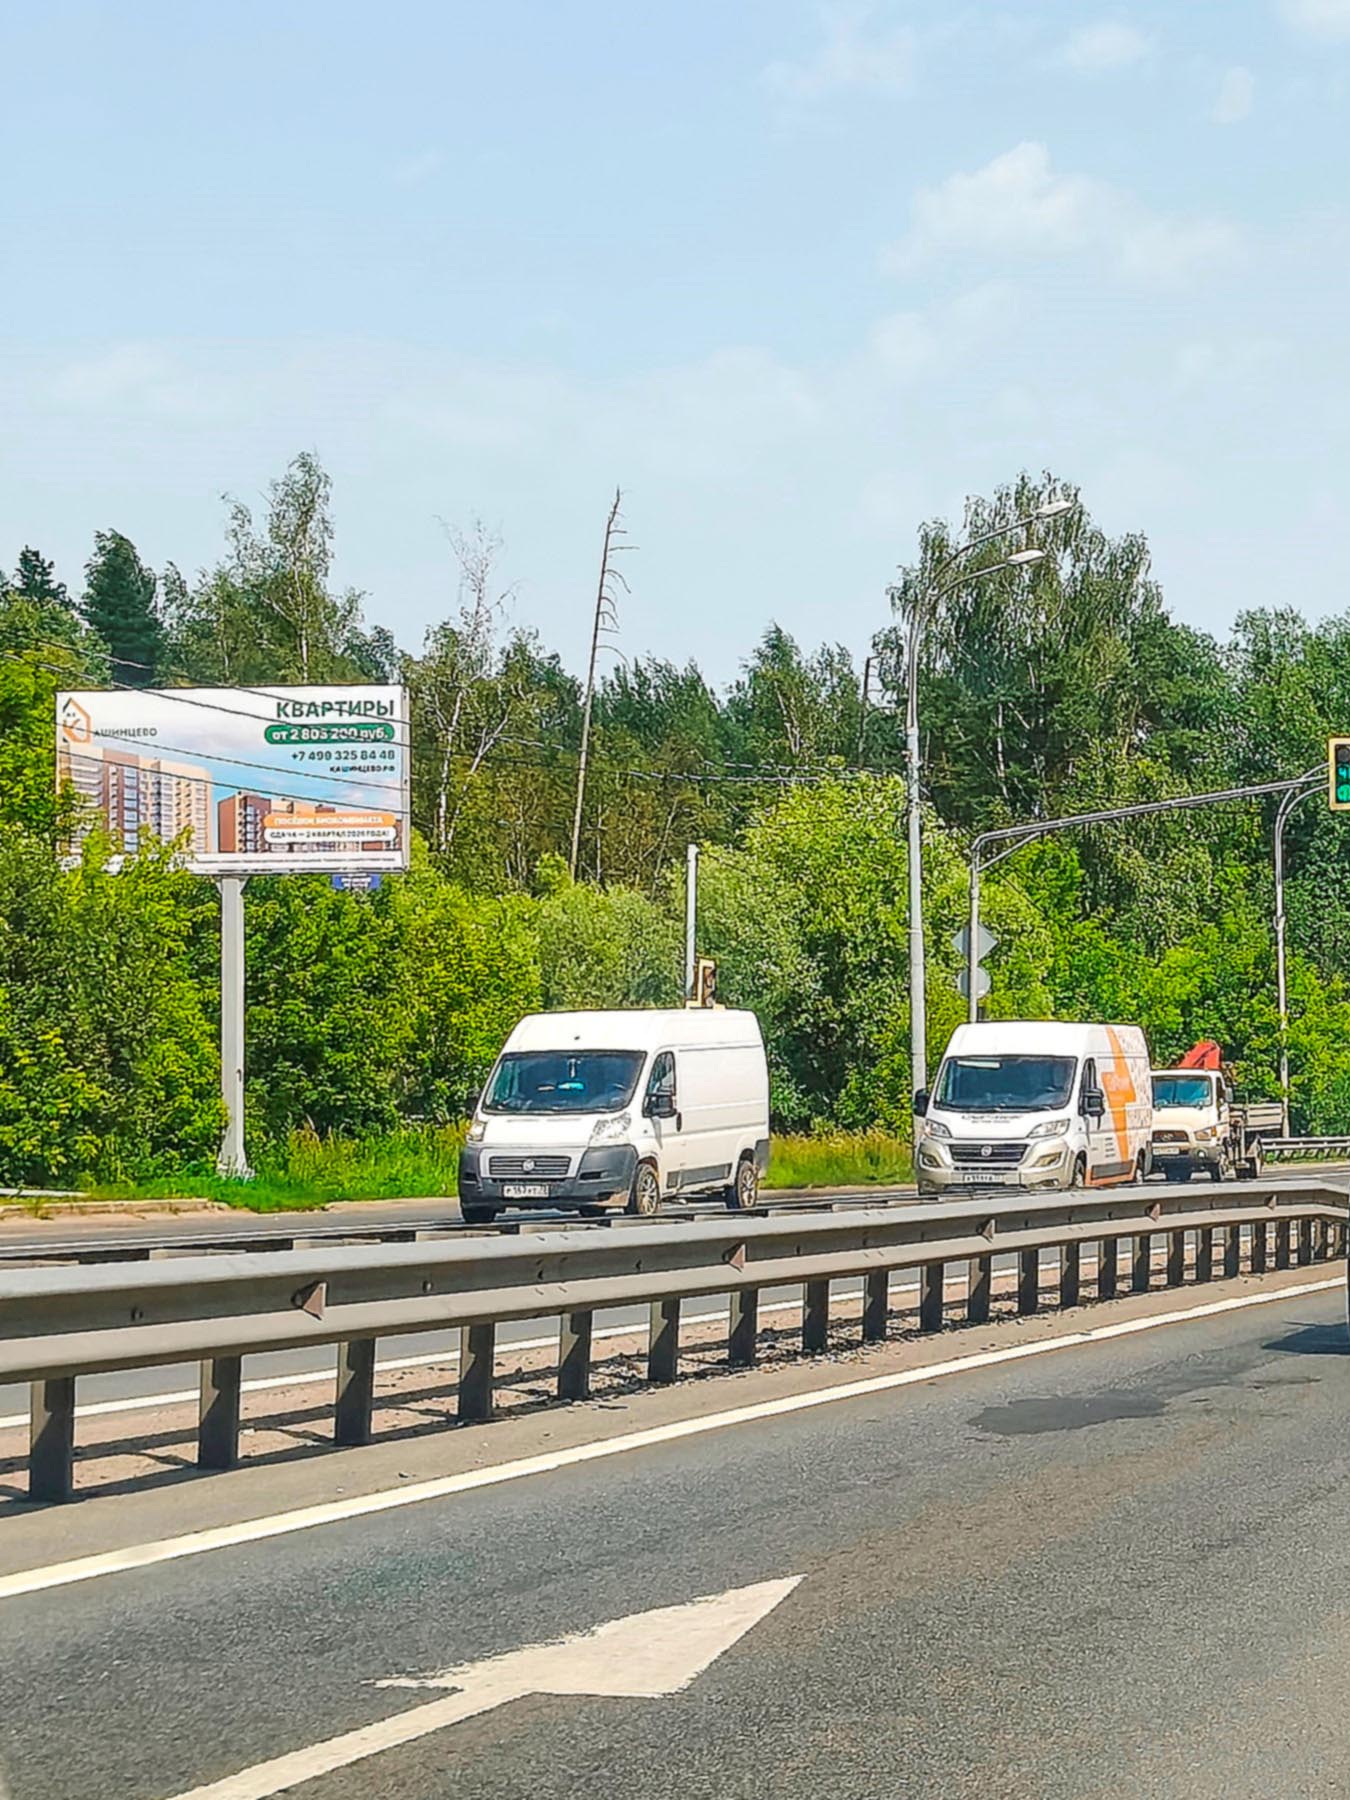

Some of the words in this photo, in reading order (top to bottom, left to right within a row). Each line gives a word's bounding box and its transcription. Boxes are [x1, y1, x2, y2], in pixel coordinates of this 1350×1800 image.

[276, 700, 395, 718] КВАРТИРЫ
[272, 730, 288, 740] от
[290, 729, 300, 740] 2
[291, 751, 306, 761] +7
[334, 750, 359, 761] 325
[360, 750, 377, 760] 84
